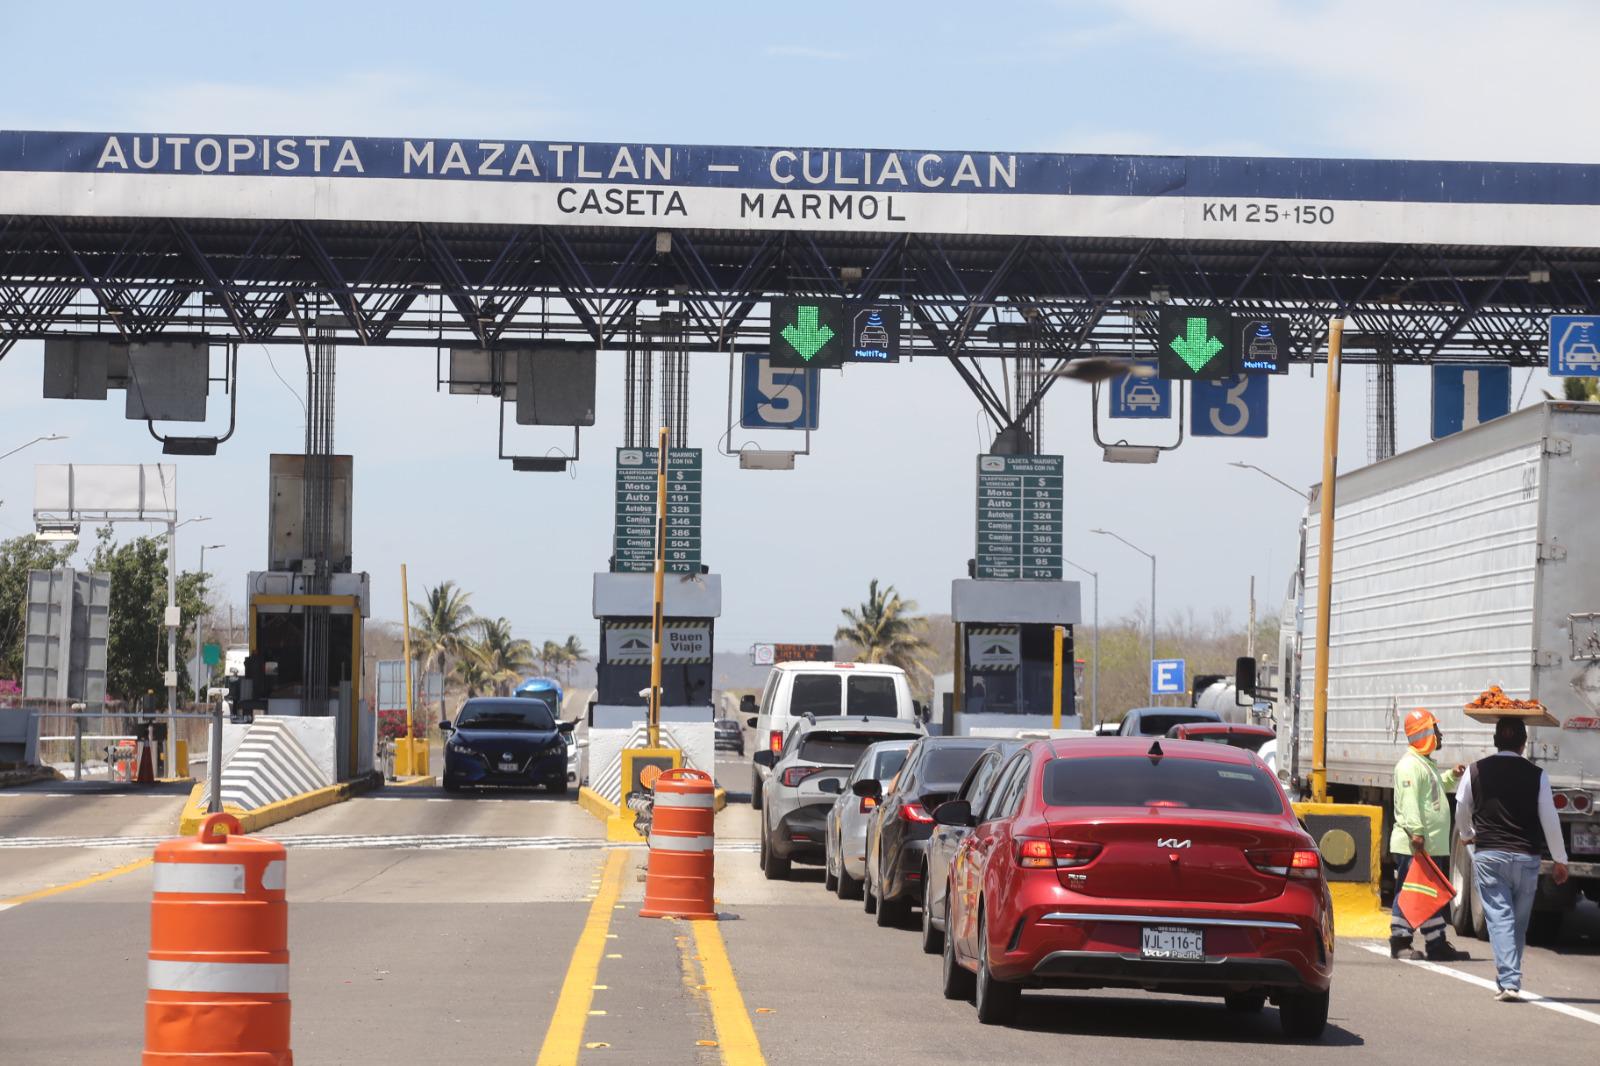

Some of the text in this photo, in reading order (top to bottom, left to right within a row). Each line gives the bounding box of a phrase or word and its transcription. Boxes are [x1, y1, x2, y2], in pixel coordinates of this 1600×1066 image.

[96, 136, 365, 173] AUTOPISTA
[403, 141, 672, 181] MAZATLAN
[769, 150, 1017, 188] CULIACAN
[557, 187, 906, 221] CASETA MARMOL
[1203, 203, 1335, 225] KM 25+150
[854, 350, 888, 359] MultiTag
[1244, 361, 1276, 371] MultiTag
[757, 358, 805, 424] 5
[1462, 369, 1481, 431] 1
[1209, 373, 1250, 435] 3
[670, 632, 703, 642] Buen
[671, 642, 702, 653] Viaje
[1157, 662, 1178, 692] E
[1157, 838, 1192, 848] KIA
[1144, 934, 1202, 951] VJL-116-C
[1172, 950, 1200, 960] Pacific
